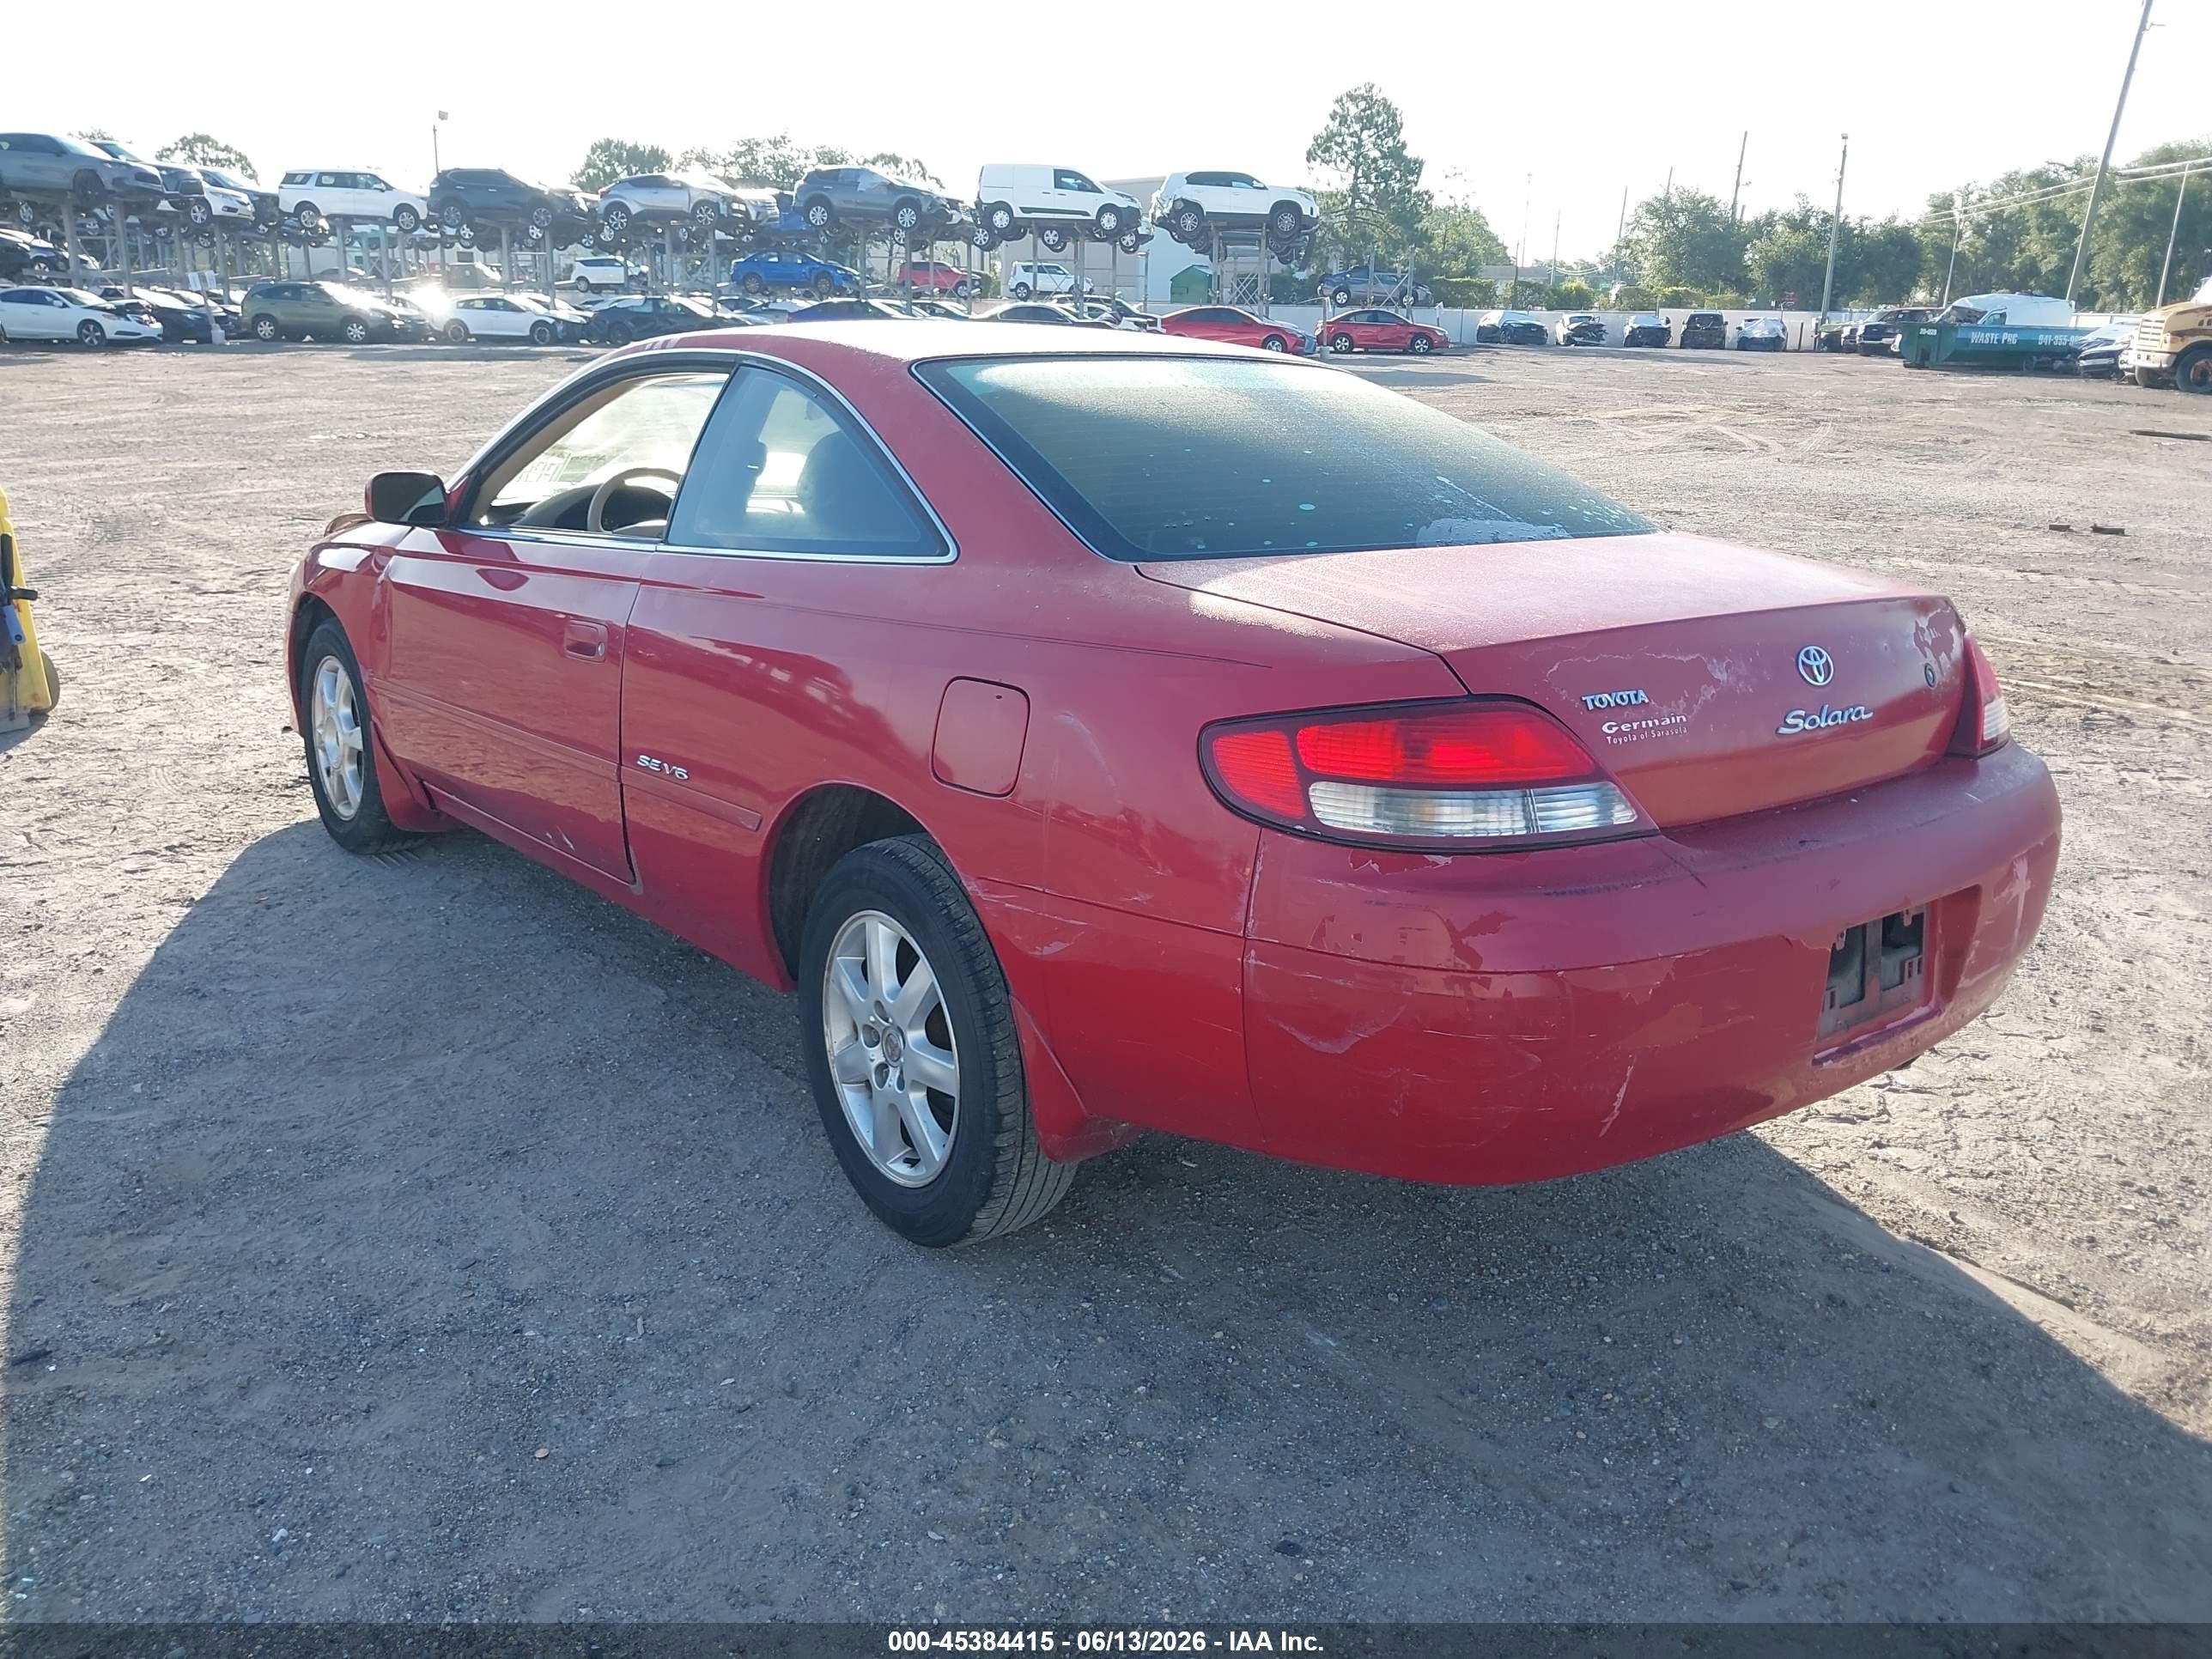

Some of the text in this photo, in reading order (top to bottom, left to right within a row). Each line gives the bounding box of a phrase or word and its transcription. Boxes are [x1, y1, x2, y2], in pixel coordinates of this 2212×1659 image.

[1971, 331, 2000, 344] WASTE
[1582, 689, 1650, 711] TOYOTA
[1601, 713, 1687, 734] Germain
[1776, 703, 1875, 735] Solara
[1607, 726, 1687, 745] Toyota of Sarasota
